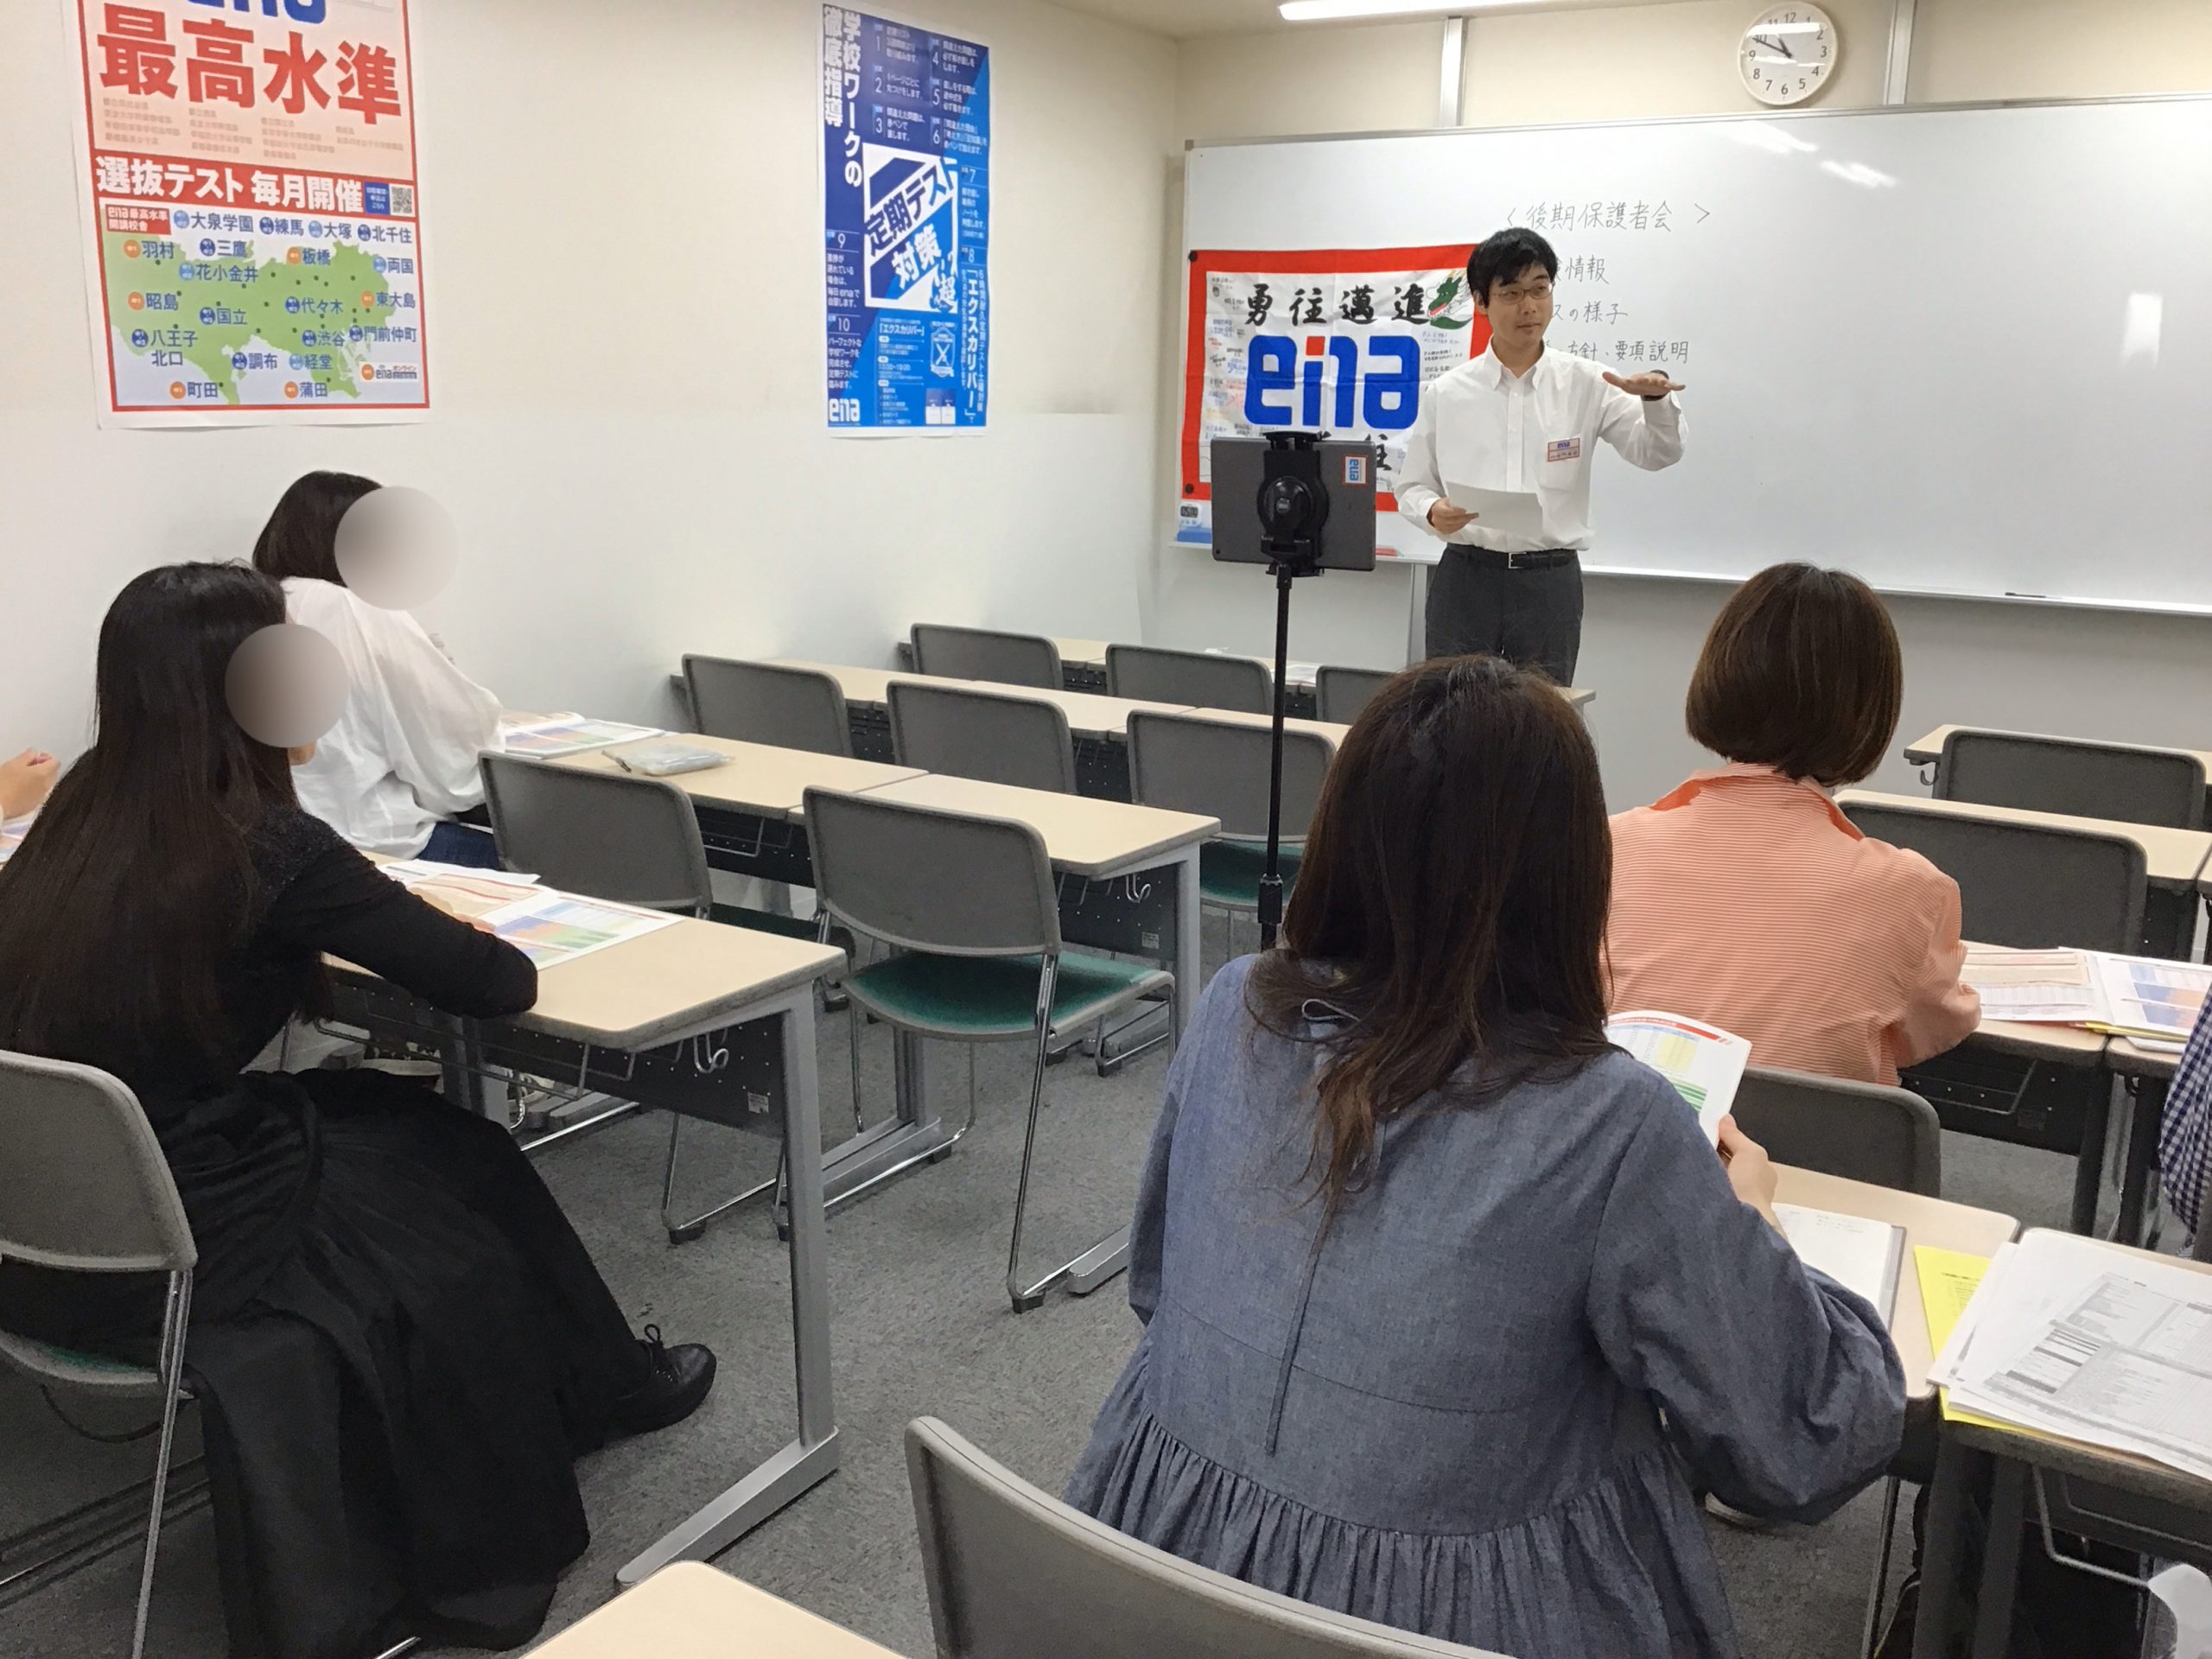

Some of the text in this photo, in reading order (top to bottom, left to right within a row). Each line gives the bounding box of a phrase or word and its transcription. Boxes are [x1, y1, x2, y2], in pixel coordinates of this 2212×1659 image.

[1784, 12, 1796, 23] 12
[1816, 30, 1823, 40] 2
[932, 52, 939, 66] 4
[1749, 50, 1756, 61] 9
[1821, 46, 1827, 58] 3
[98, 3, 402, 124] 最高水準
[1811, 66, 1819, 76] 4
[1753, 68, 1760, 79] 8
[874, 78, 882, 93] 2
[1765, 79, 1772, 91] 7
[1781, 84, 1788, 95] 6
[1799, 79, 1806, 89] 5
[843, 11, 862, 188] 学校ワークの
[932, 92, 940, 105] 5
[875, 118, 882, 133] 3
[933, 131, 940, 144] 6
[969, 169, 976, 183] 7
[95, 156, 364, 213] 選抜テスト 毎月開催
[864, 157, 957, 257] 定期テスト
[191, 213, 253, 232] 大泉学園
[274, 219, 304, 236] 練馬
[324, 223, 352, 238] 大塚
[372, 226, 412, 244] 北千住
[837, 233, 845, 248] 9
[143, 241, 175, 258] 羽村
[217, 239, 247, 257] 三鷹
[968, 249, 975, 263] 8
[303, 248, 331, 265] 板橋
[892, 223, 941, 290] 対策
[195, 264, 258, 283] 花小金井
[388, 257, 414, 274] 両国
[146, 293, 179, 310] 昭島
[301, 298, 344, 315] 代々木
[377, 292, 416, 308] 東大島
[1244, 283, 1430, 327] 勇往邁進
[217, 309, 248, 325] 国立
[838, 318, 850, 332] 10
[151, 329, 198, 346] 八王子
[317, 330, 345, 346] 渋谷
[364, 327, 416, 343] 門前仲町
[152, 350, 183, 366] 北口
[249, 353, 277, 369] 調布
[304, 353, 332, 369] 経堂
[188, 382, 219, 397] 町田
[300, 382, 327, 397] 蒲田
[829, 398, 861, 422] ena
